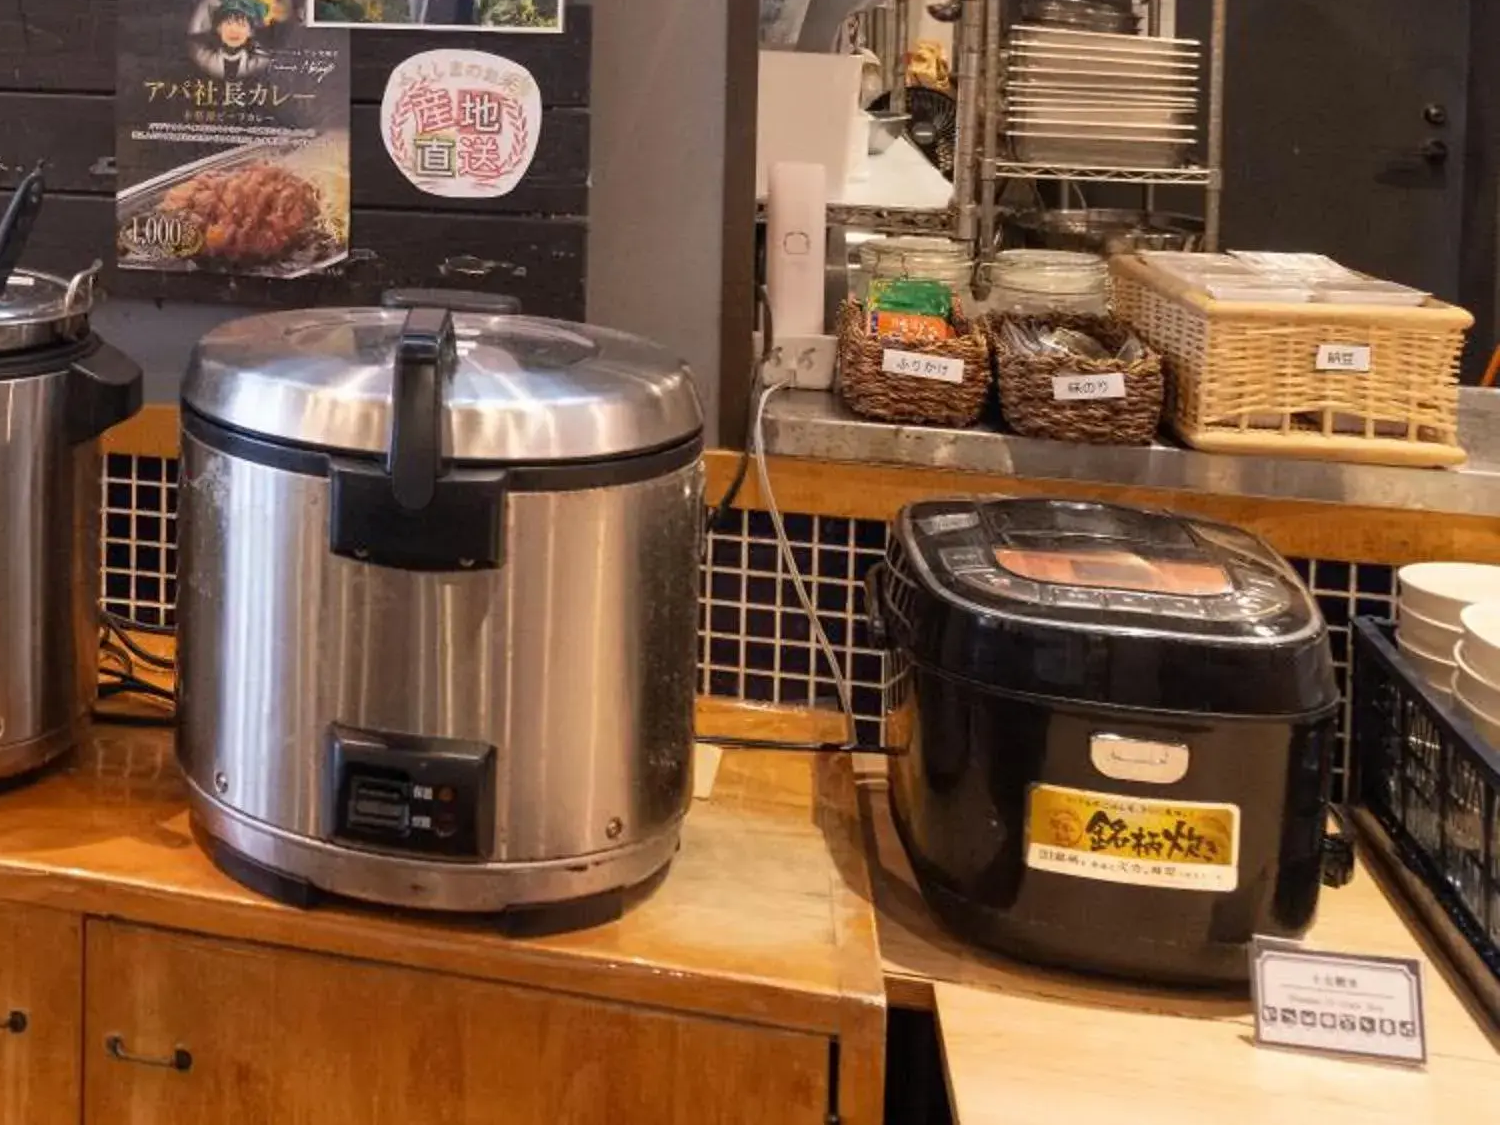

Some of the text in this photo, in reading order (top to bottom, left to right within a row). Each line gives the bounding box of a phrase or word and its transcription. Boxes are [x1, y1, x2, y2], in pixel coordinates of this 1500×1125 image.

[144, 76, 317, 107] アパ社長カレー
[414, 136, 501, 177] 直送
[895, 356, 949, 374] ふりかけ
[1085, 810, 1217, 862] 銘柄炊き
